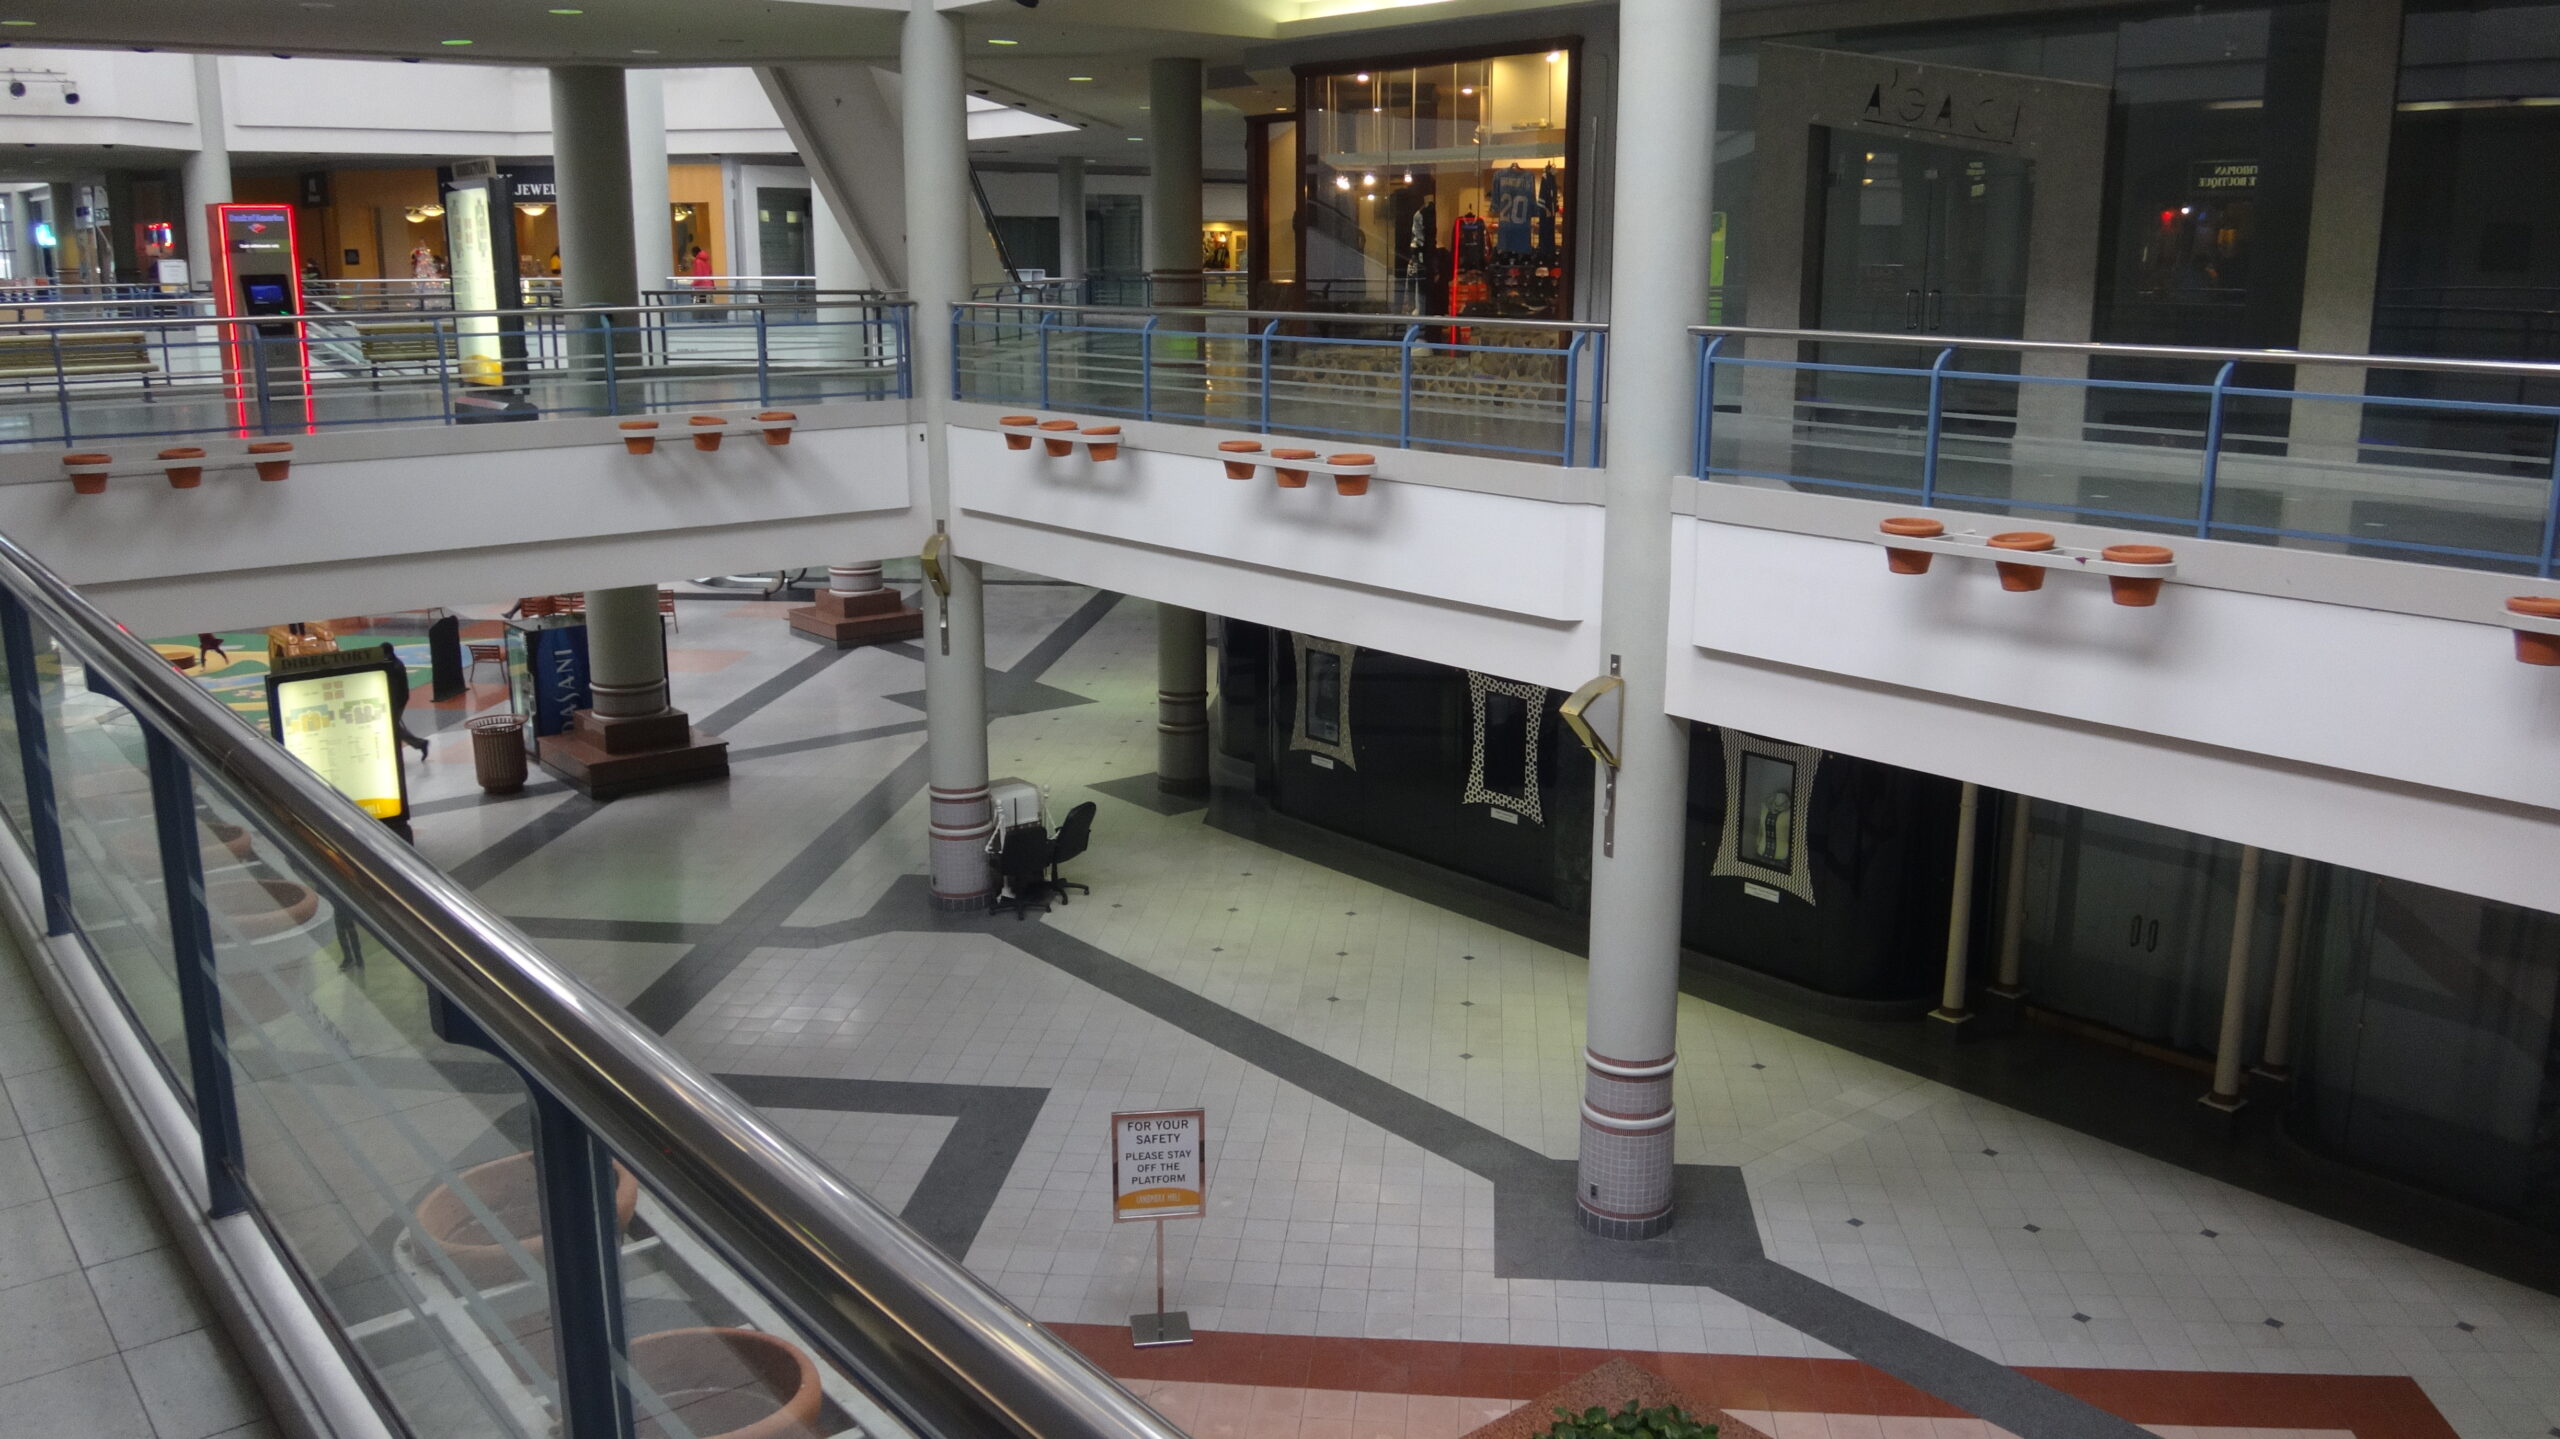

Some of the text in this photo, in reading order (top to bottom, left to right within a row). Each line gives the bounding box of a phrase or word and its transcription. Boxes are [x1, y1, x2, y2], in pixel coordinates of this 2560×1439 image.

[1499, 193, 1528, 224] 20
[282, 651, 371, 668] DIRECTORY
[1127, 1119, 1189, 1132] FOR YOUR
[1136, 1133, 1181, 1145] SAFETY
[1125, 1150, 1191, 1161] PLEASE STAY
[1137, 1162, 1180, 1173] OFF THE
[1131, 1174, 1186, 1185] PLATFORM
